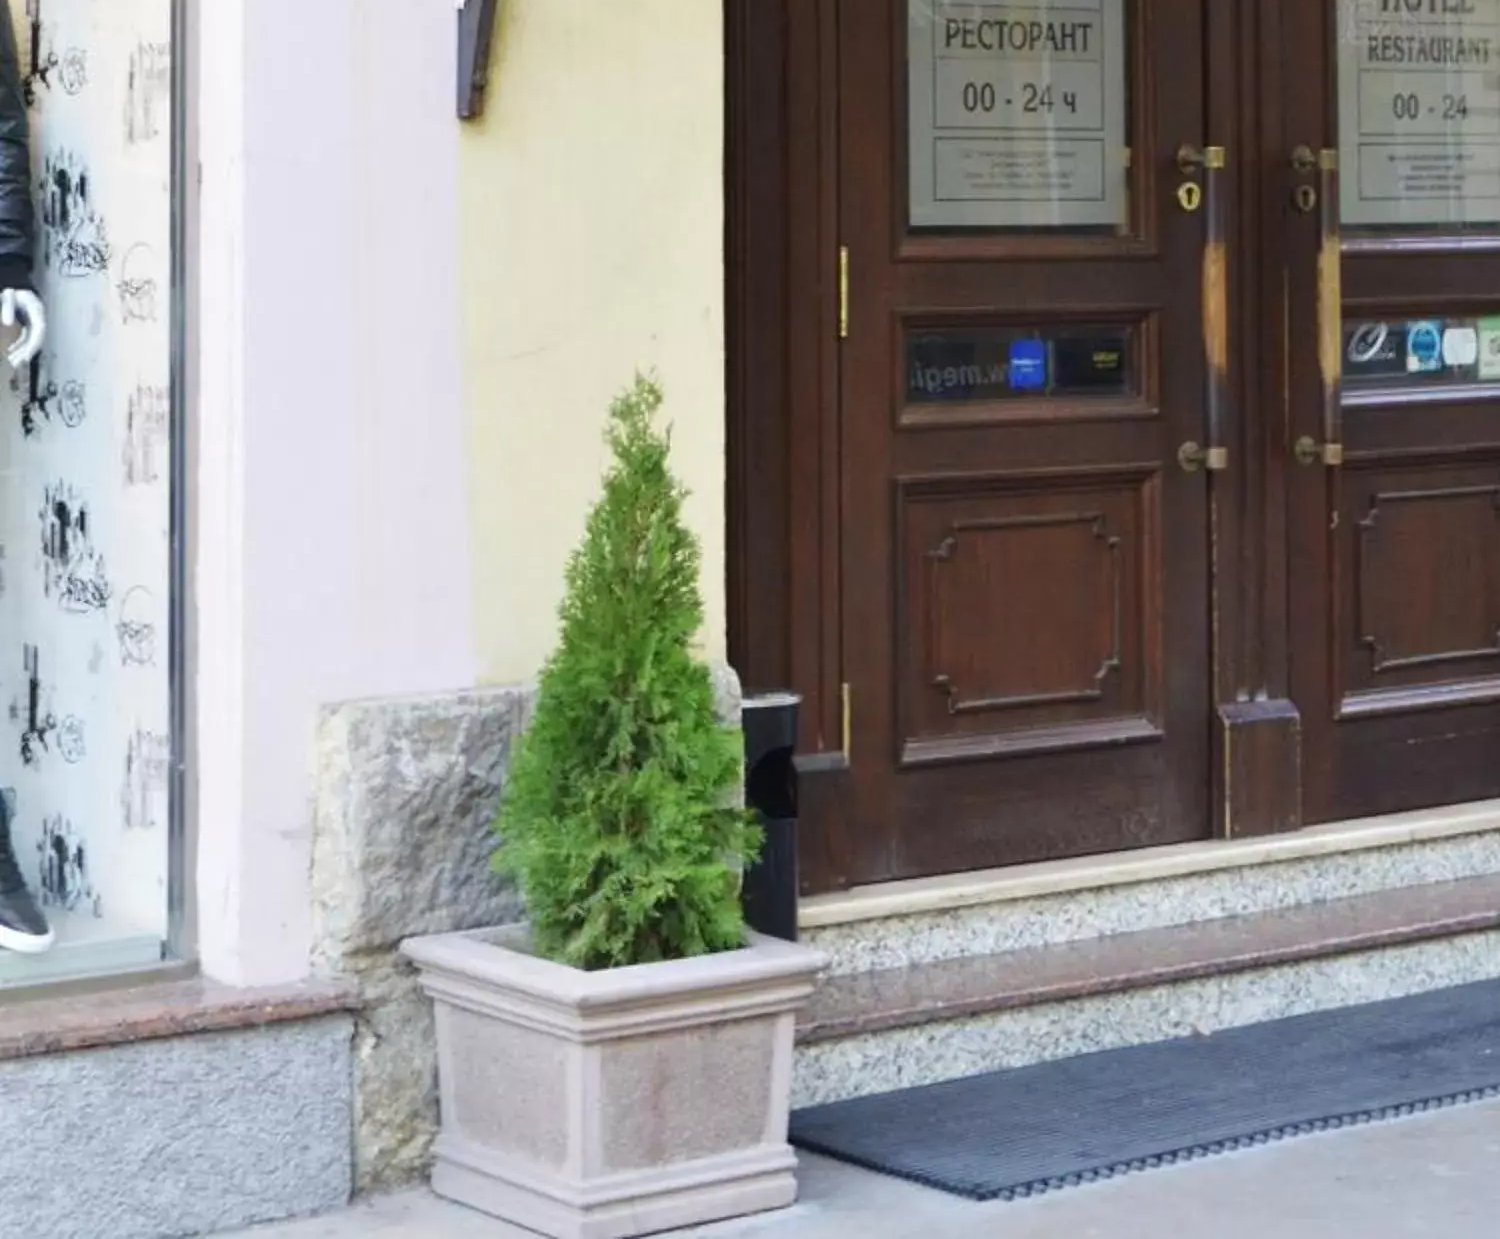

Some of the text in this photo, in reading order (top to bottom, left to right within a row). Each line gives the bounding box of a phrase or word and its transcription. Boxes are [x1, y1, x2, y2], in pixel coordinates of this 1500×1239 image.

[945, 18, 1093, 52] РЕСТОРАНТ
[1368, 34, 1491, 64] RESTAURANT
[963, 82, 995, 113] 00
[1023, 83, 1055, 113] 24
[1392, 93, 1420, 120] 00
[1442, 94, 1468, 120] 24
